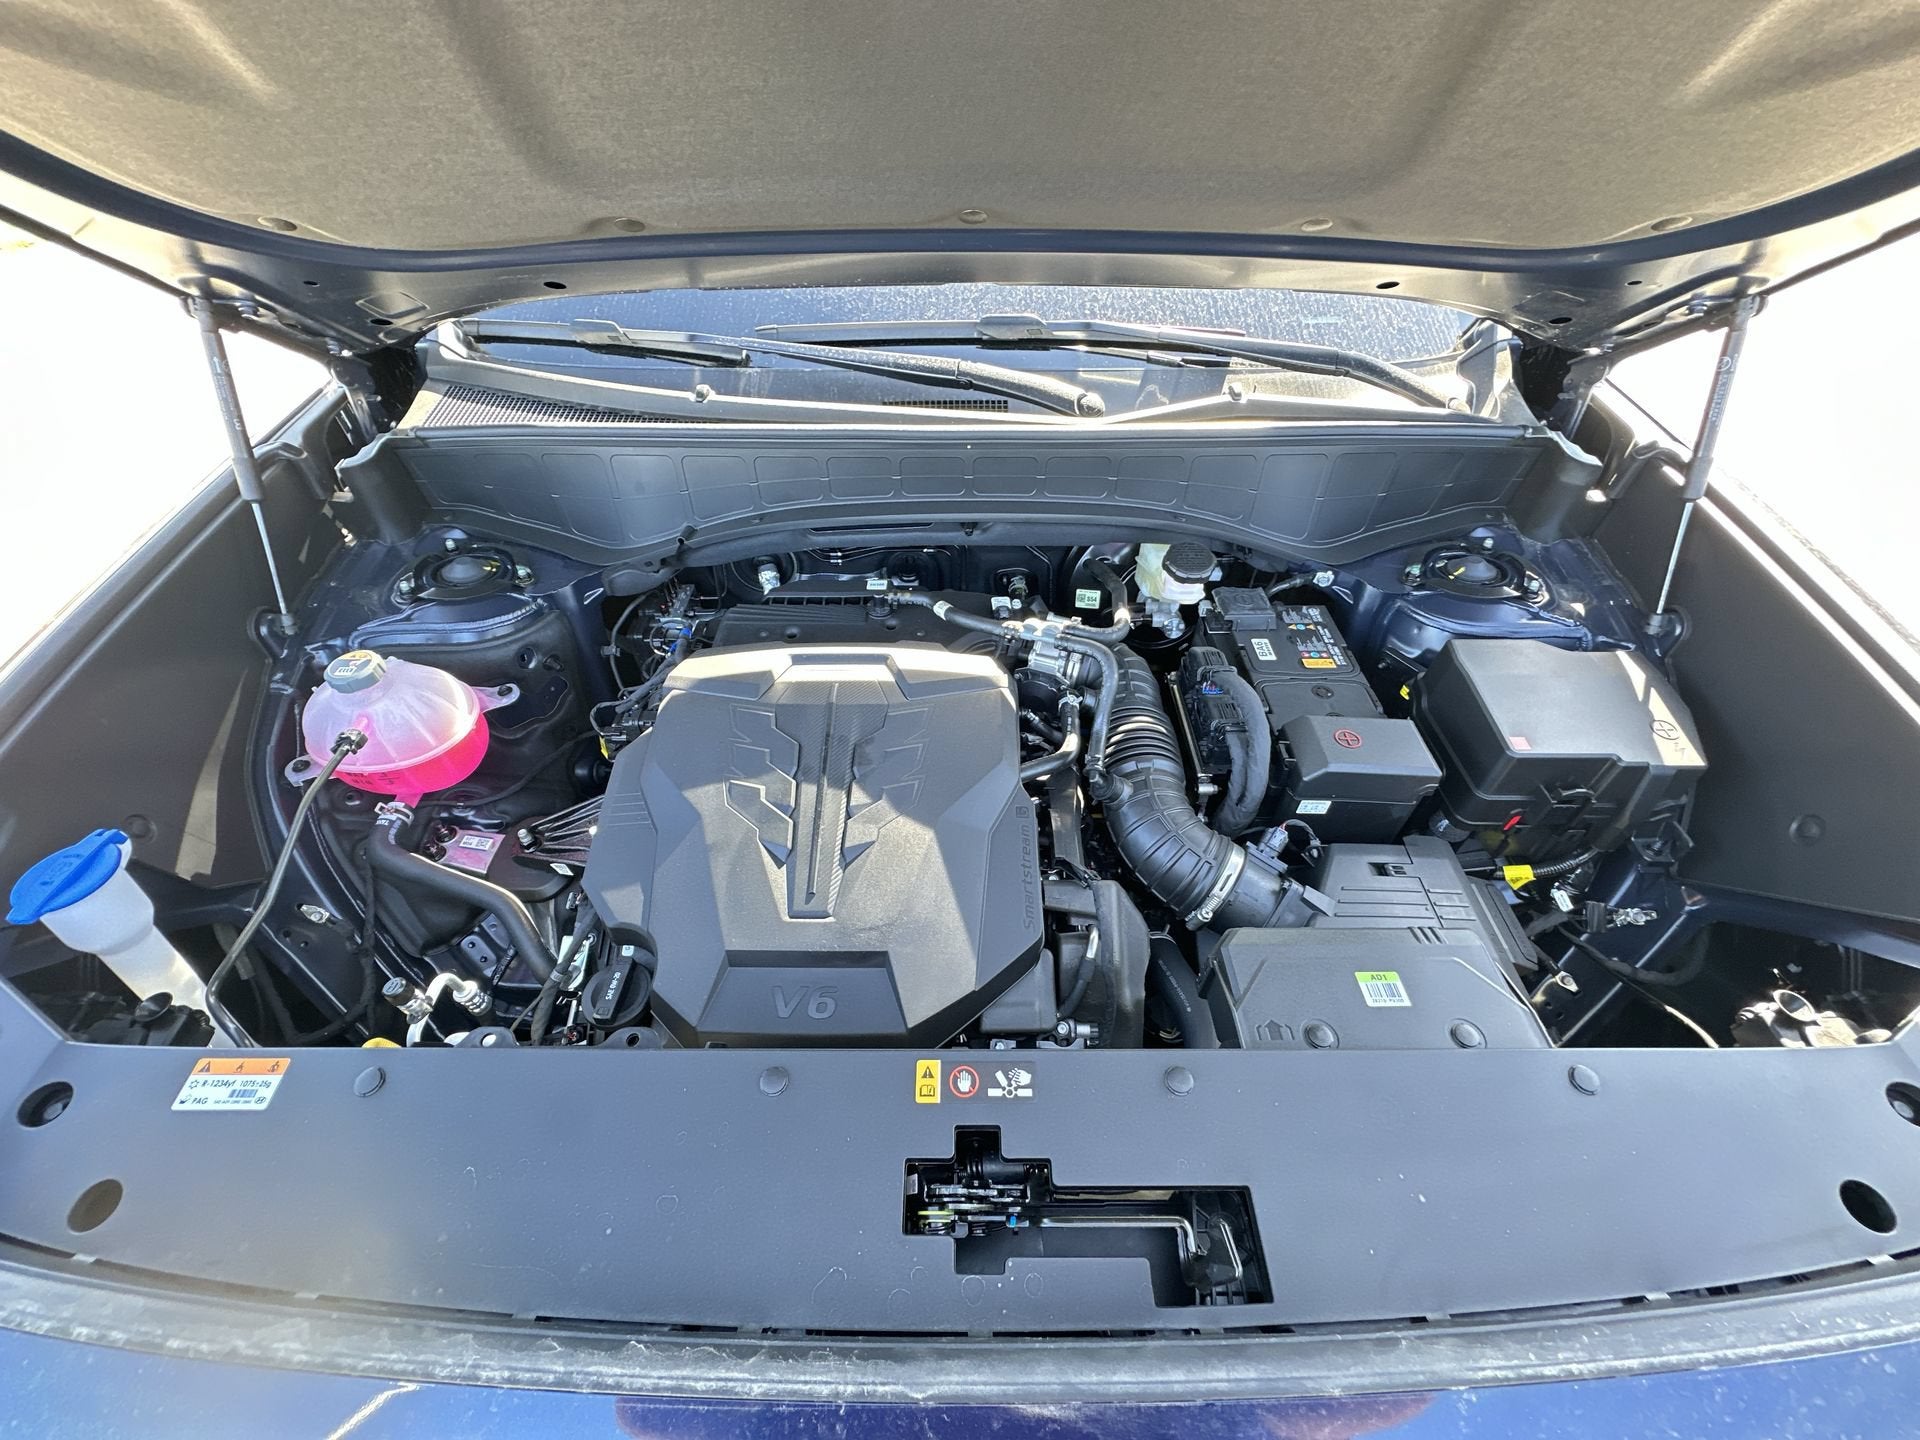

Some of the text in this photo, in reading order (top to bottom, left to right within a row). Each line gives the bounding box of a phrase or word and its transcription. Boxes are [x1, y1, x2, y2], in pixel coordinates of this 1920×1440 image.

[1022, 824, 1035, 933] Smartstream
[605, 989, 615, 1000] SAE
[770, 985, 838, 1020] V6
[191, 1097, 209, 1105] PAG
